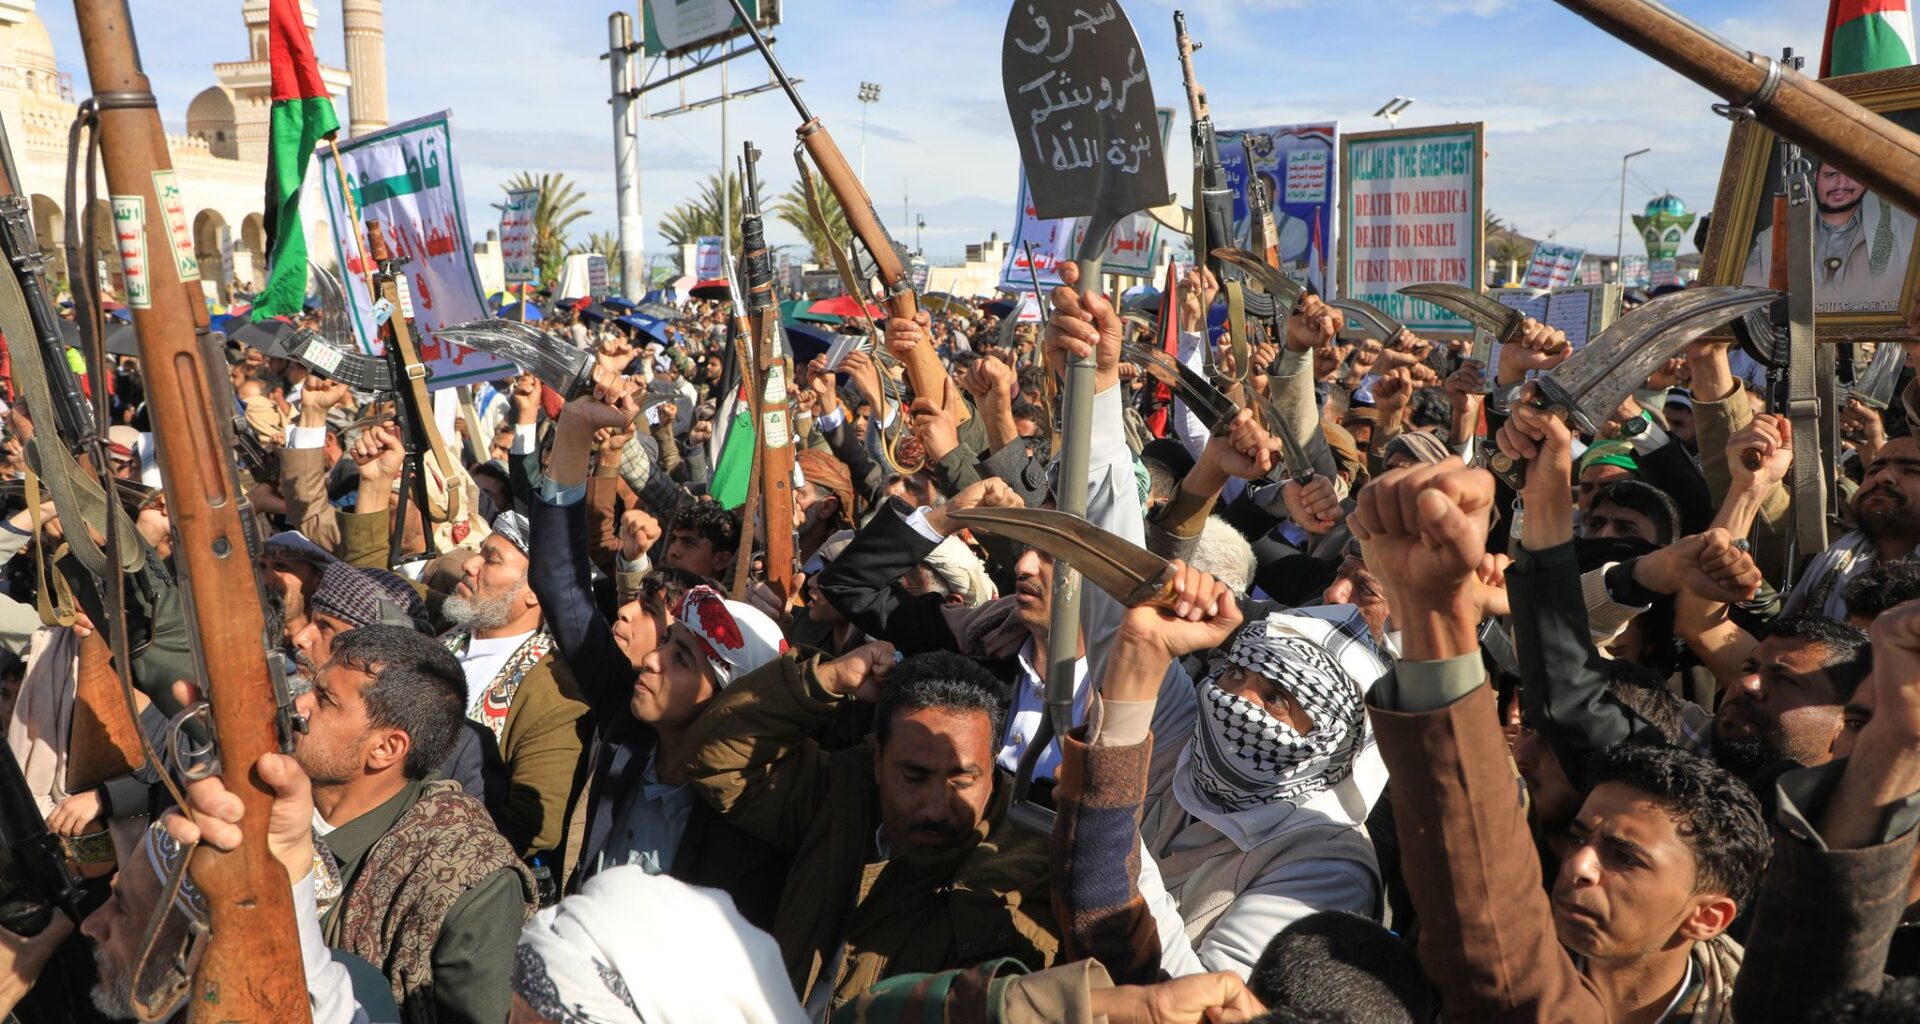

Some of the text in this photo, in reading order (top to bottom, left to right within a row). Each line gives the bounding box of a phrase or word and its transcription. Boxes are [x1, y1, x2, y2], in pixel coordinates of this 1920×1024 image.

[1051, 120, 1099, 171] الله
[1355, 141, 1472, 180] ALLAH IS THE GREATEST
[1355, 189, 1467, 217] DEATH TO AMERICA
[1355, 223, 1457, 248] DEATH TO ISRAEL
[1355, 258, 1467, 284] CURSE UPON THE JEWS
[1409, 295, 1426, 320] TO
